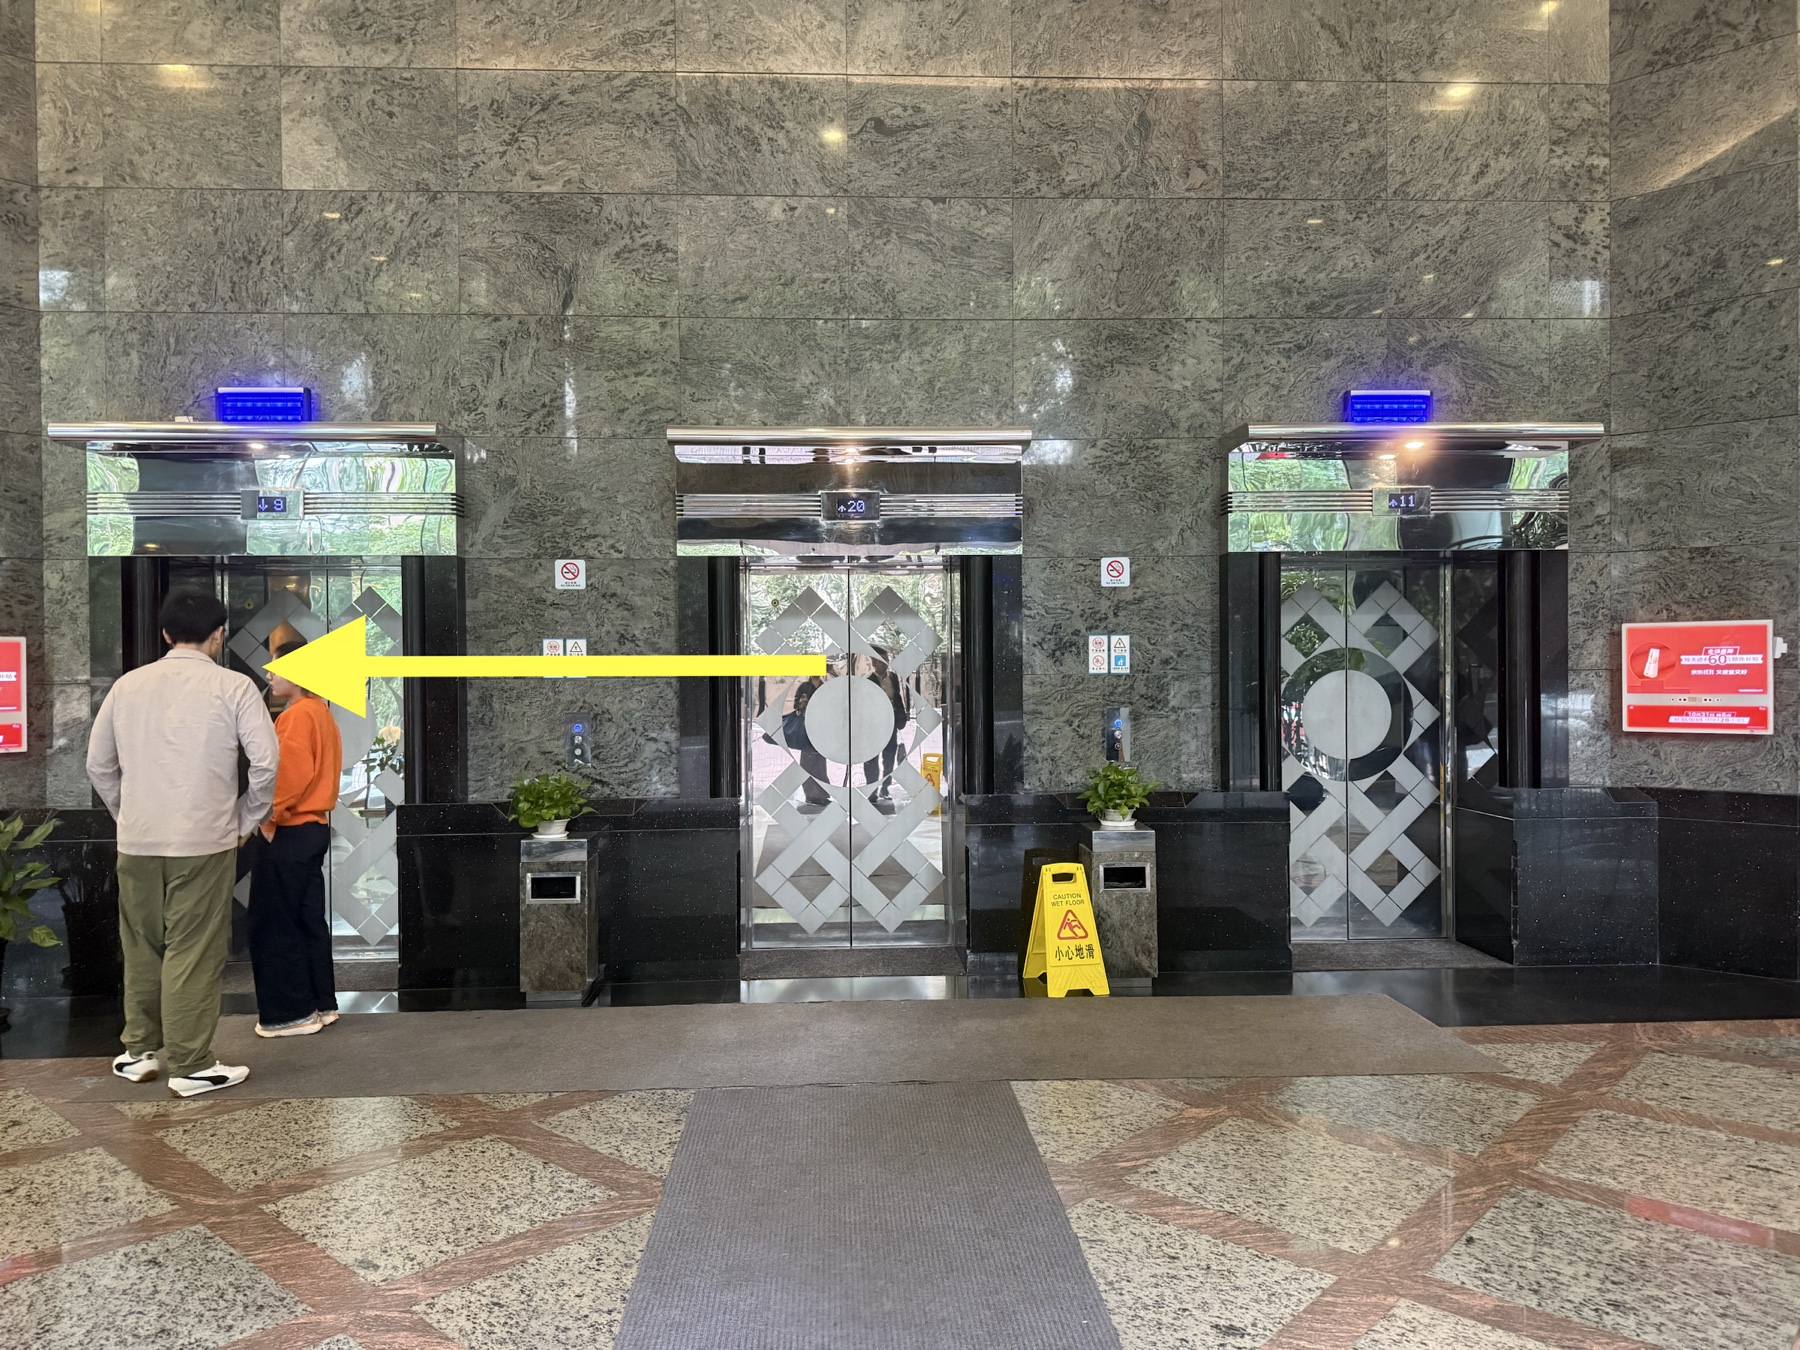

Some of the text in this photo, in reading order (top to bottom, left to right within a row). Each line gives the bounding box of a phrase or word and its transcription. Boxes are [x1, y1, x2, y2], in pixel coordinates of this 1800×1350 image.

[274, 498, 283, 511] 9
[847, 500, 865, 512] 20
[1400, 495, 1415, 507] 11
[1055, 943, 1094, 961] 小心地滑
